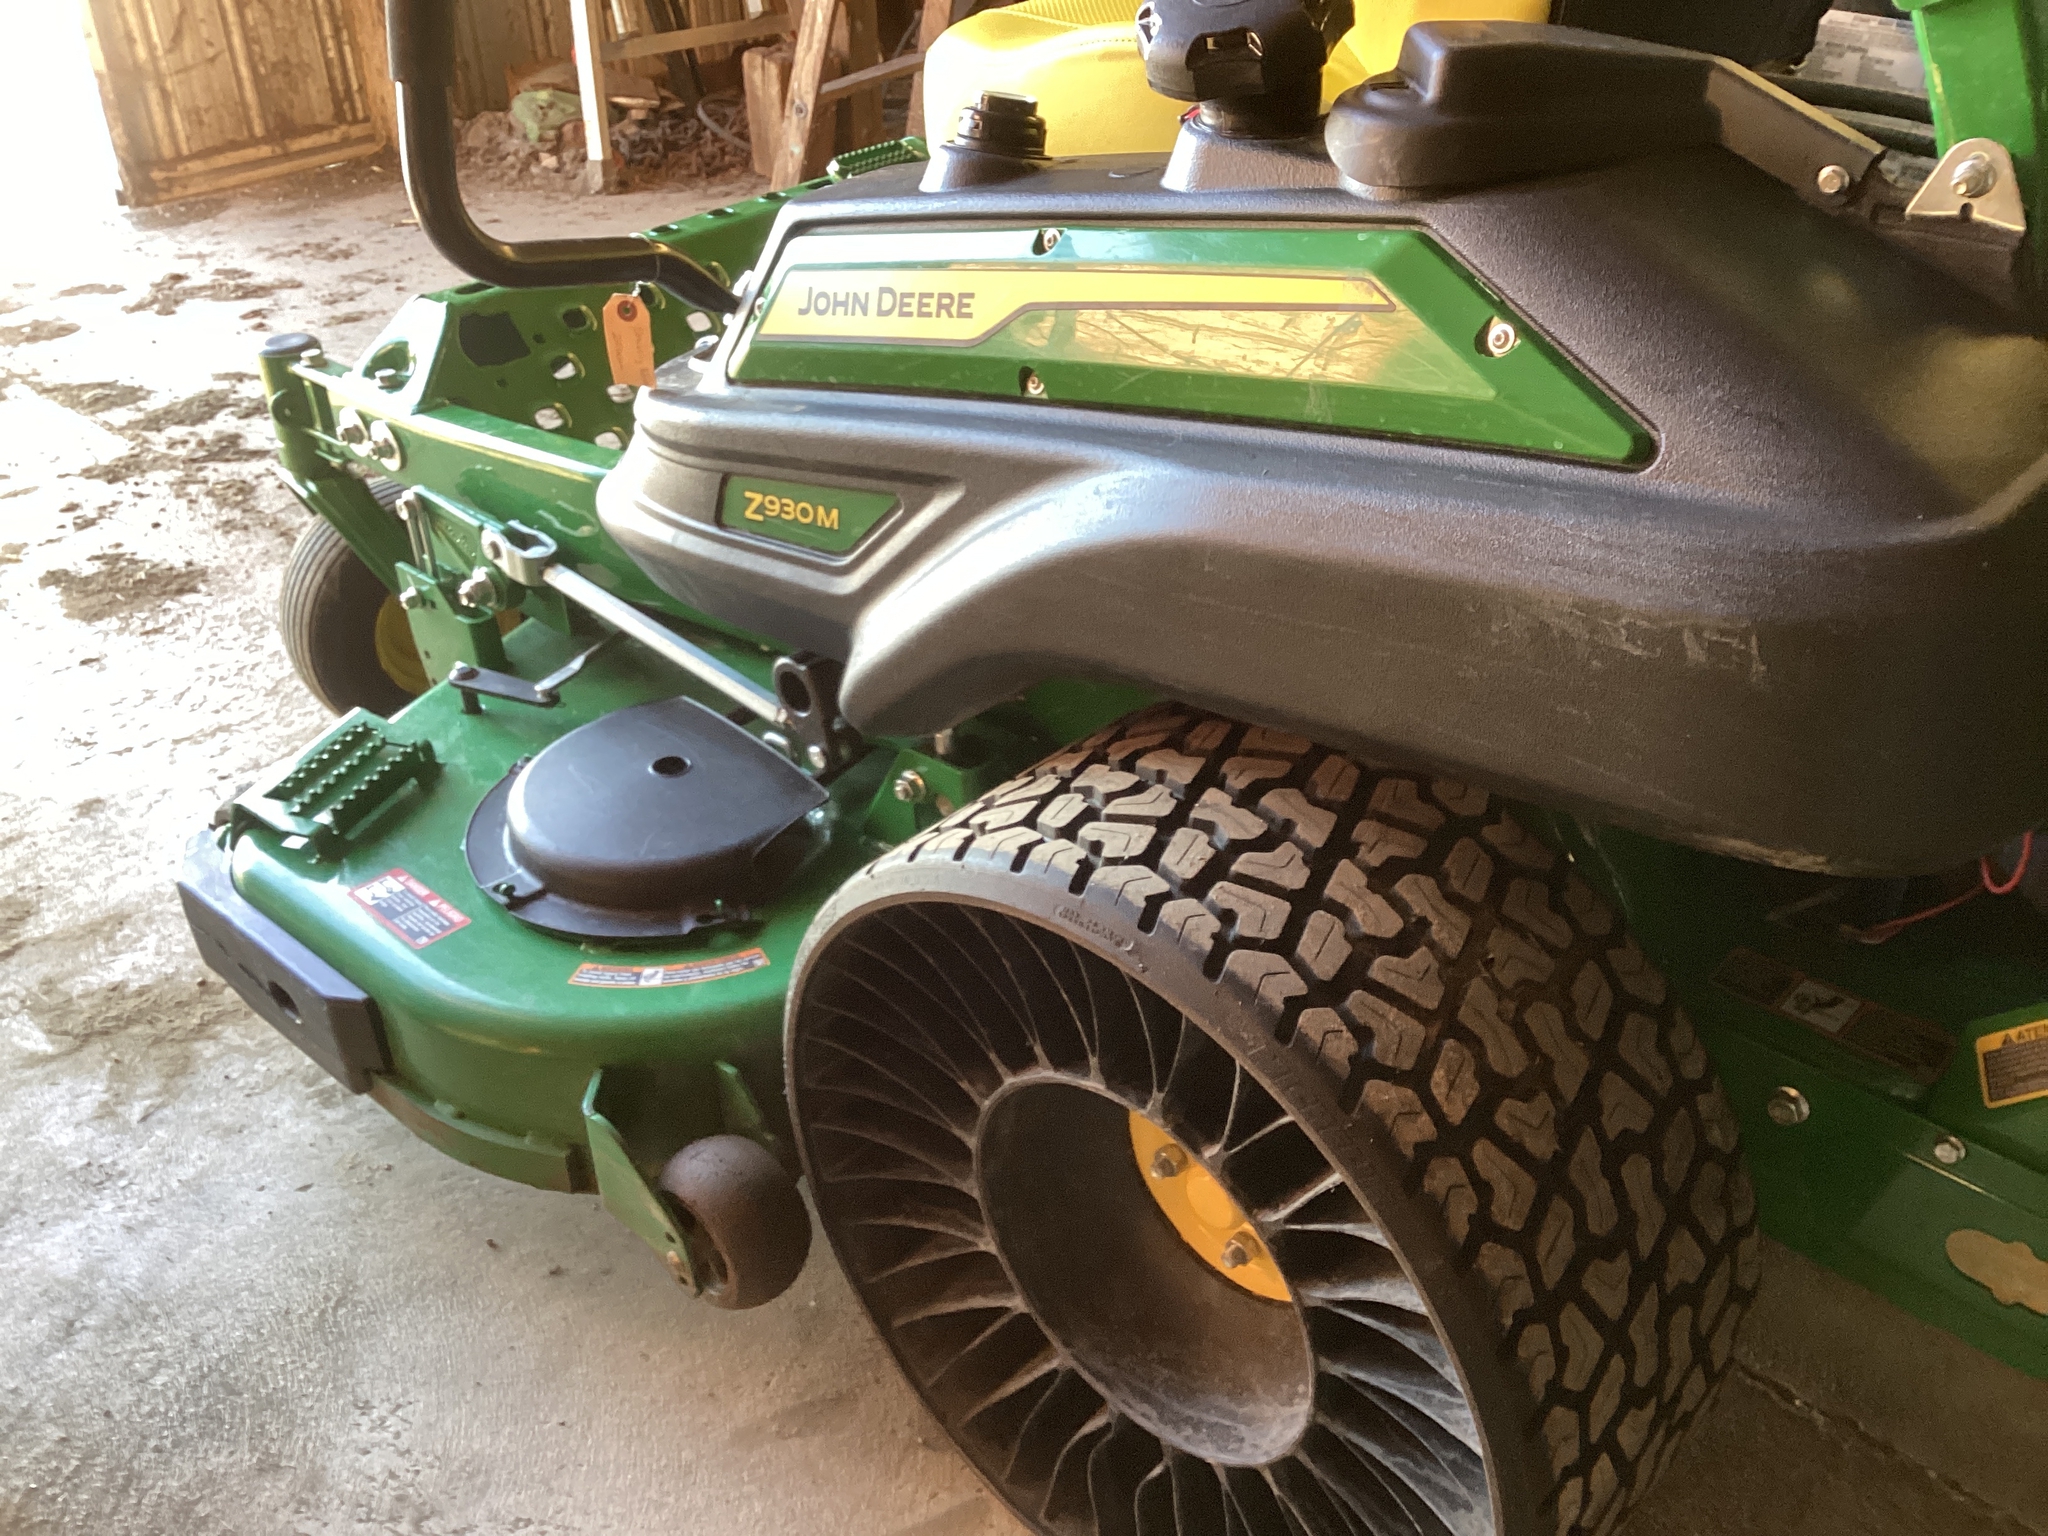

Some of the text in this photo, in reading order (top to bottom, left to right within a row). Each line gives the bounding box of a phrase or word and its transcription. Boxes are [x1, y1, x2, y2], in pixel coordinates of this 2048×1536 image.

[798, 286, 975, 319] JOHN DEERE
[744, 491, 839, 530] Z930M
